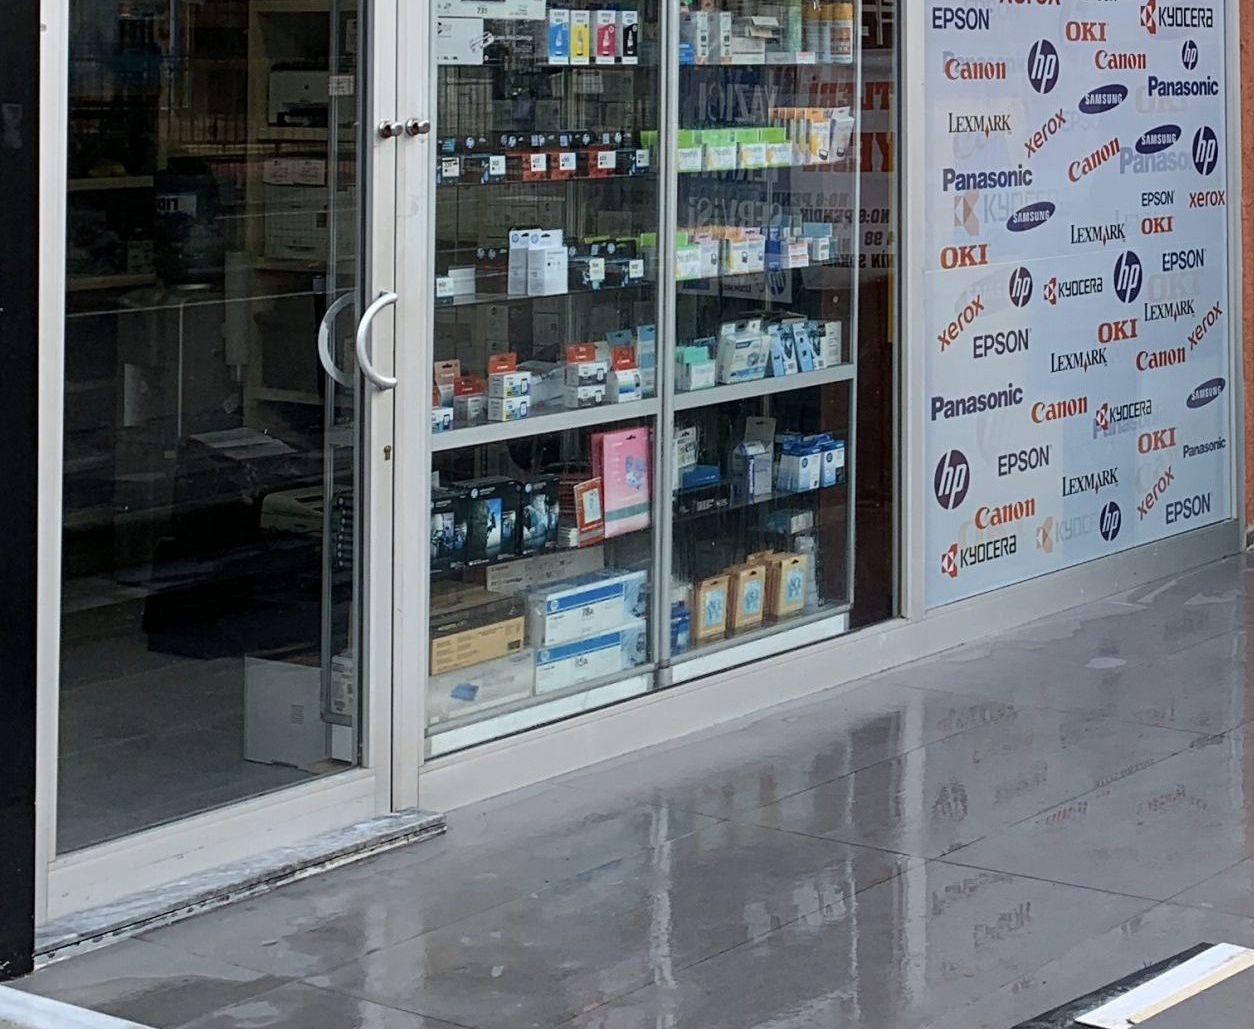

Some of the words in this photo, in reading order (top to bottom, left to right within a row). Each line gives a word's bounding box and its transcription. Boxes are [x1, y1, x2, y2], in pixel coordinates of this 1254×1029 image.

[932, 7, 990, 30] EPSON
[1065, 21, 1106, 41] OKI
[1031, 39, 1056, 94] hp
[1095, 50, 1146, 70] Canon
[1183, 40, 1197, 70] hp
[944, 58, 1006, 80] Canon
[1085, 92, 1123, 105] SAMSUNG
[1148, 75, 1219, 97] Panasonic
[949, 112, 1011, 137] LEXMARK
[1024, 109, 1066, 158] xerox
[1141, 132, 1177, 145] SAMSUNG
[1194, 126, 1217, 175] hp
[1068, 137, 1120, 182] Canon
[943, 164, 1033, 192] Panasonic
[1142, 190, 1174, 206] EPSON
[1189, 189, 1225, 208] xerox
[1013, 208, 1050, 223] SAMSUNG
[1141, 216, 1174, 235] OKI
[1071, 223, 1125, 246] LEXMARK
[940, 243, 988, 270] OKI
[1162, 249, 1204, 271] EPSON
[1011, 267, 1031, 307] hp
[1115, 251, 1141, 303] hp
[937, 294, 984, 352] xerox
[1144, 299, 1195, 322] LEXMARK
[1098, 318, 1138, 343] OKI
[1188, 301, 1223, 351] xerox
[973, 329, 1029, 359] EPSON
[1051, 347, 1107, 373] LEXMARK
[1136, 346, 1186, 371] Canon
[931, 383, 1023, 421] Panasonic
[1031, 396, 1088, 424] Canon
[1138, 427, 1177, 454] OKI
[1183, 436, 1226, 458] Panasonic
[998, 445, 1050, 477] EPSON
[936, 449, 968, 509] hp
[1063, 467, 1118, 497] LEXMARK
[1137, 466, 1175, 520] xerox
[975, 498, 1036, 530] Canon
[1101, 501, 1120, 541] hp
[1166, 493, 1212, 524] EPSON
